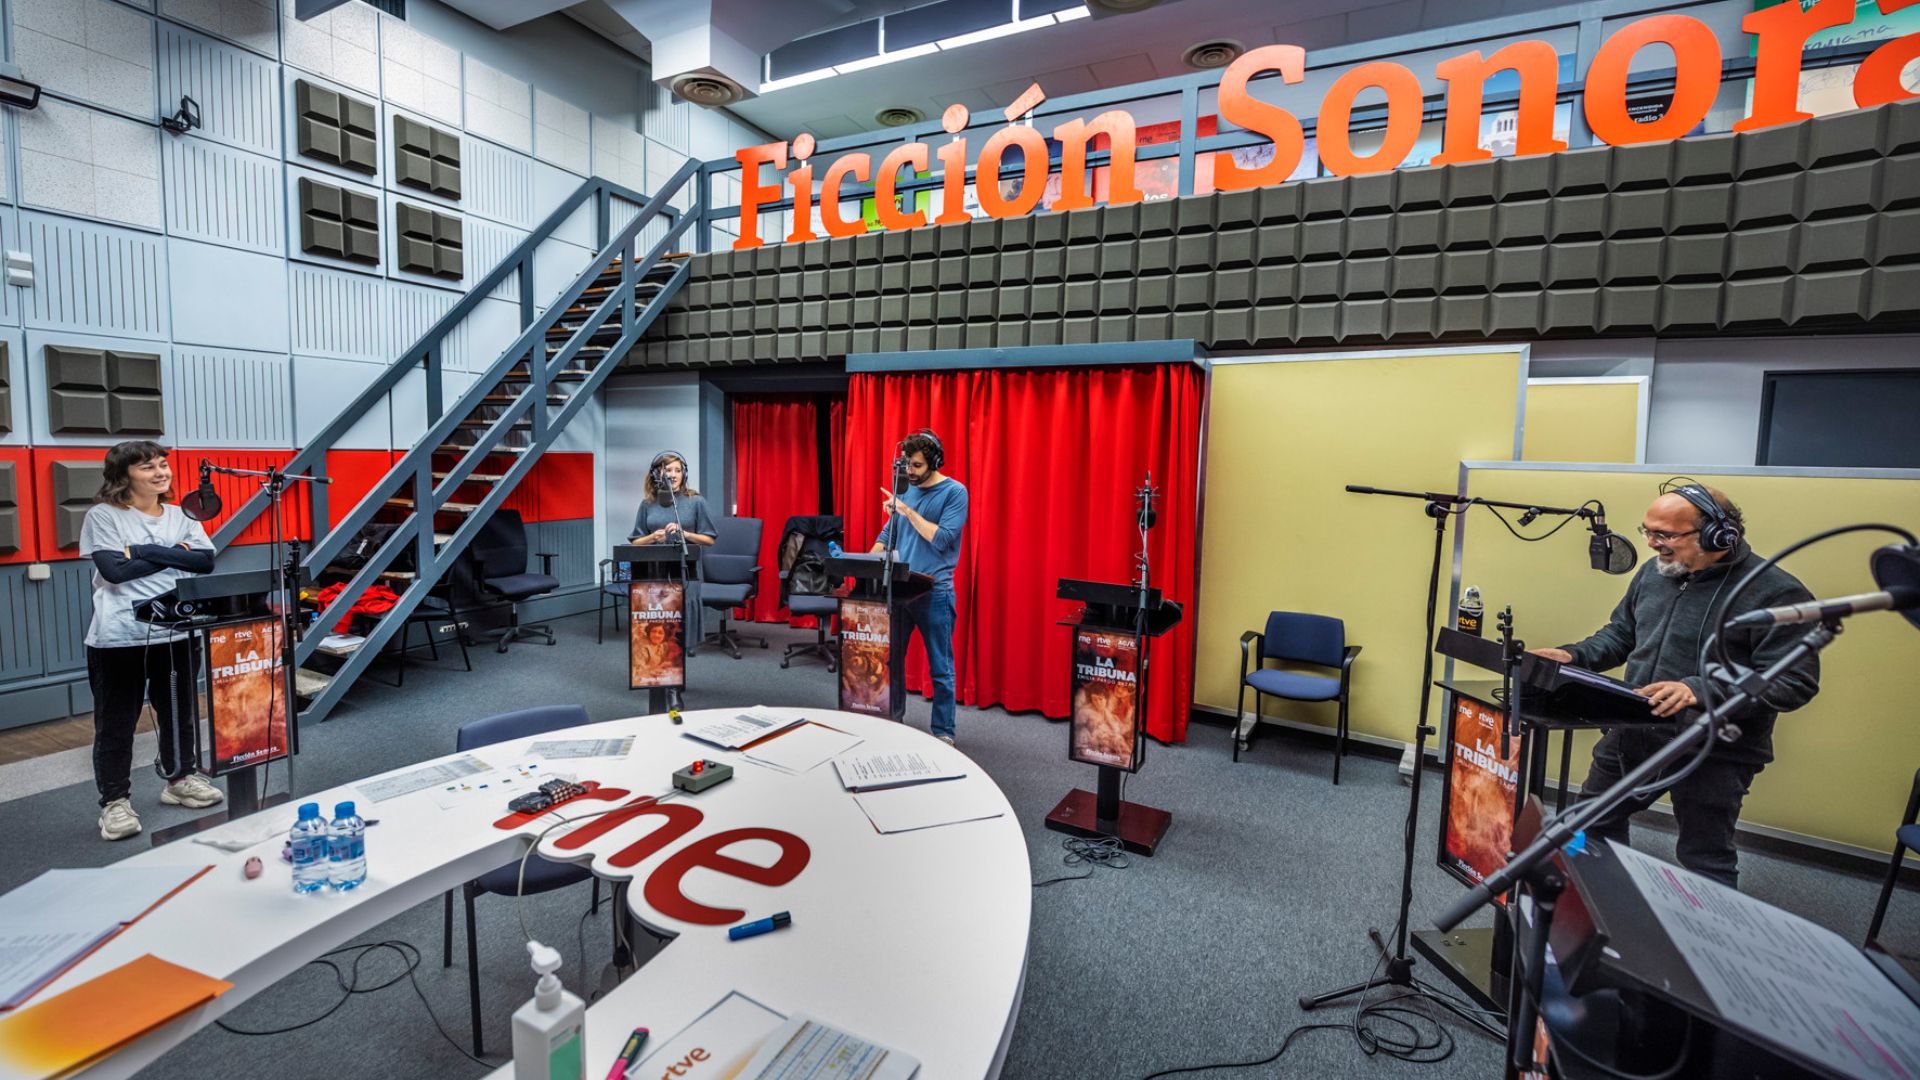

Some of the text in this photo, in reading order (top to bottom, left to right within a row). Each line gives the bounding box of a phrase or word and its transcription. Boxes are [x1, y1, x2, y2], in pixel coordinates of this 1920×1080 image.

[733, 83, 1144, 250] Ficción
[648, 603, 663, 611] LA
[632, 610, 682, 620] TRIBUNA
[1459, 616, 1477, 627] rtve
[857, 623, 871, 632] LA
[235, 630, 253, 639] rtve
[841, 631, 890, 644] TRIBUNA
[236, 650, 259, 664] LA
[1095, 656, 1114, 668] LA
[212, 656, 283, 679] TRIBUNA
[1077, 664, 1136, 683] TRIBUNA
[1476, 738, 1496, 759] LA
[1455, 742, 1518, 784] TRIBUNA
[493, 780, 811, 926] rne
